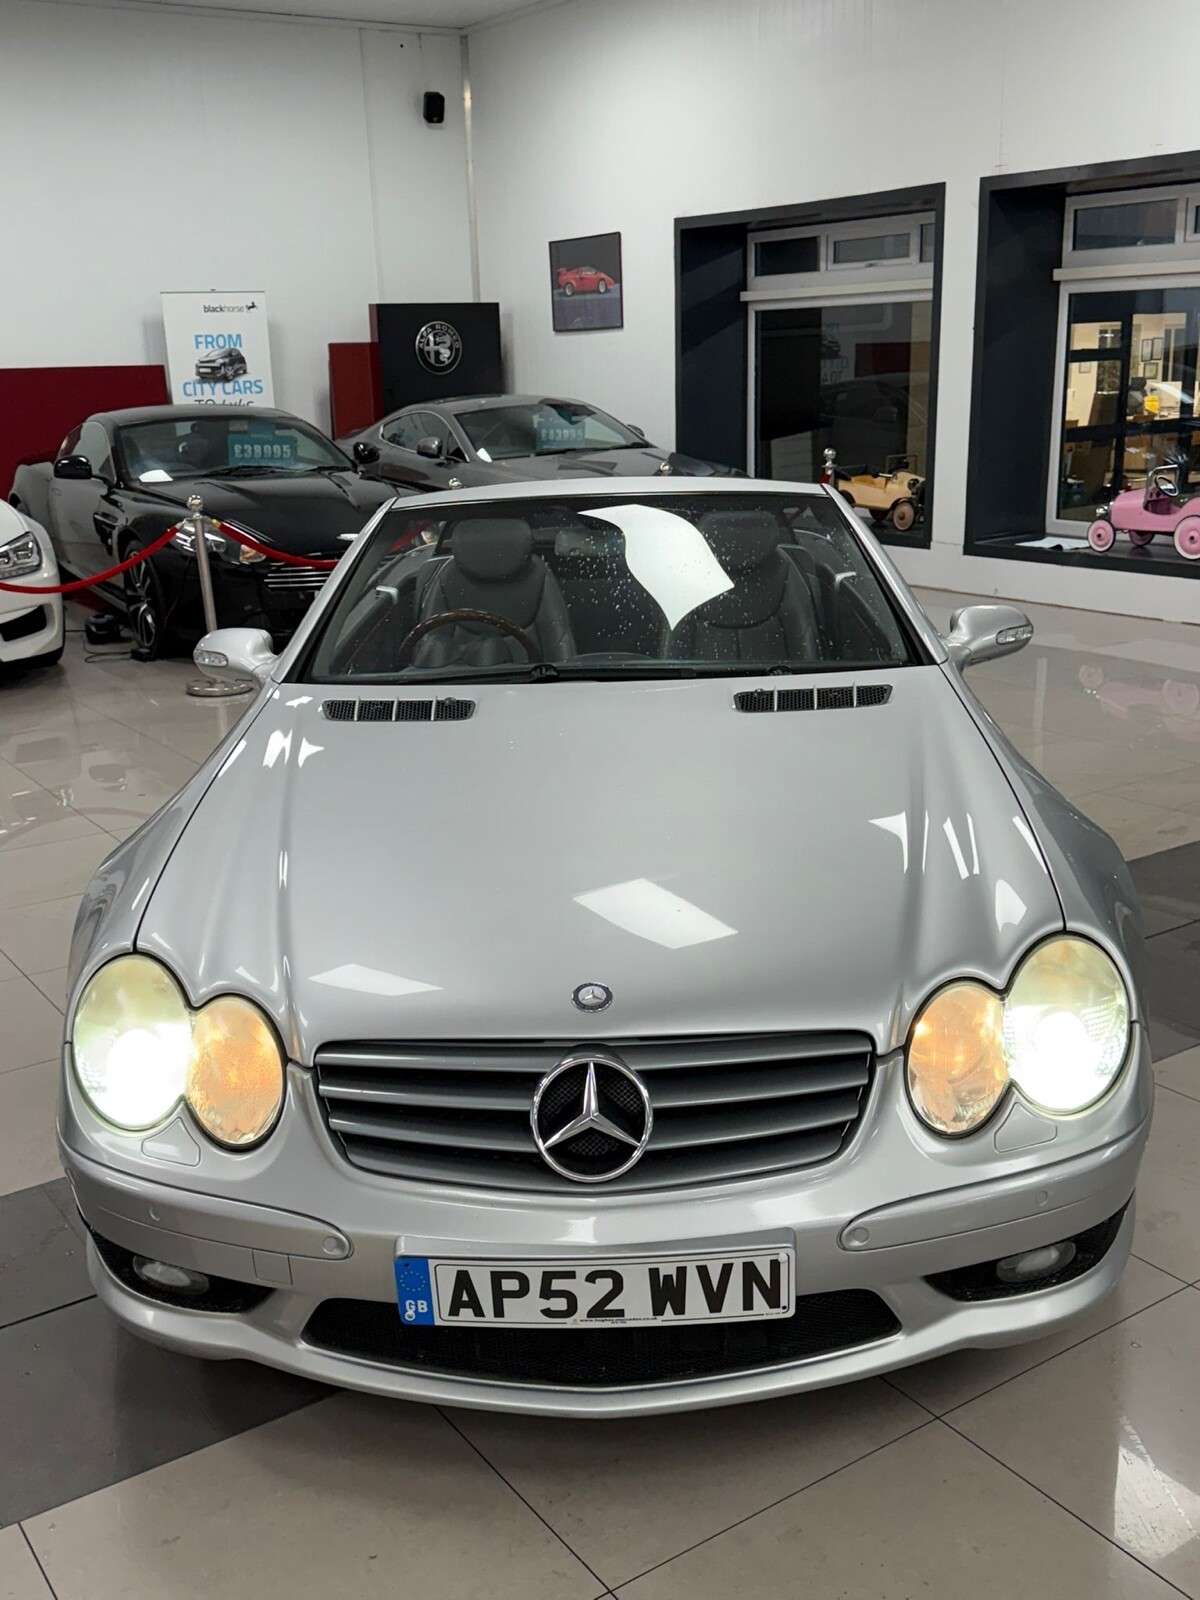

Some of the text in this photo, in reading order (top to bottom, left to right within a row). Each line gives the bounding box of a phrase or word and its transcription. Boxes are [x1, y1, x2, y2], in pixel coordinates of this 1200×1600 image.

[203, 304, 245, 313] blackhorse
[194, 333, 243, 349] FROM
[183, 379, 264, 397] CITY CARS
[447, 1258, 782, 1319] AP52 WVN
[405, 1299, 428, 1313] GB
